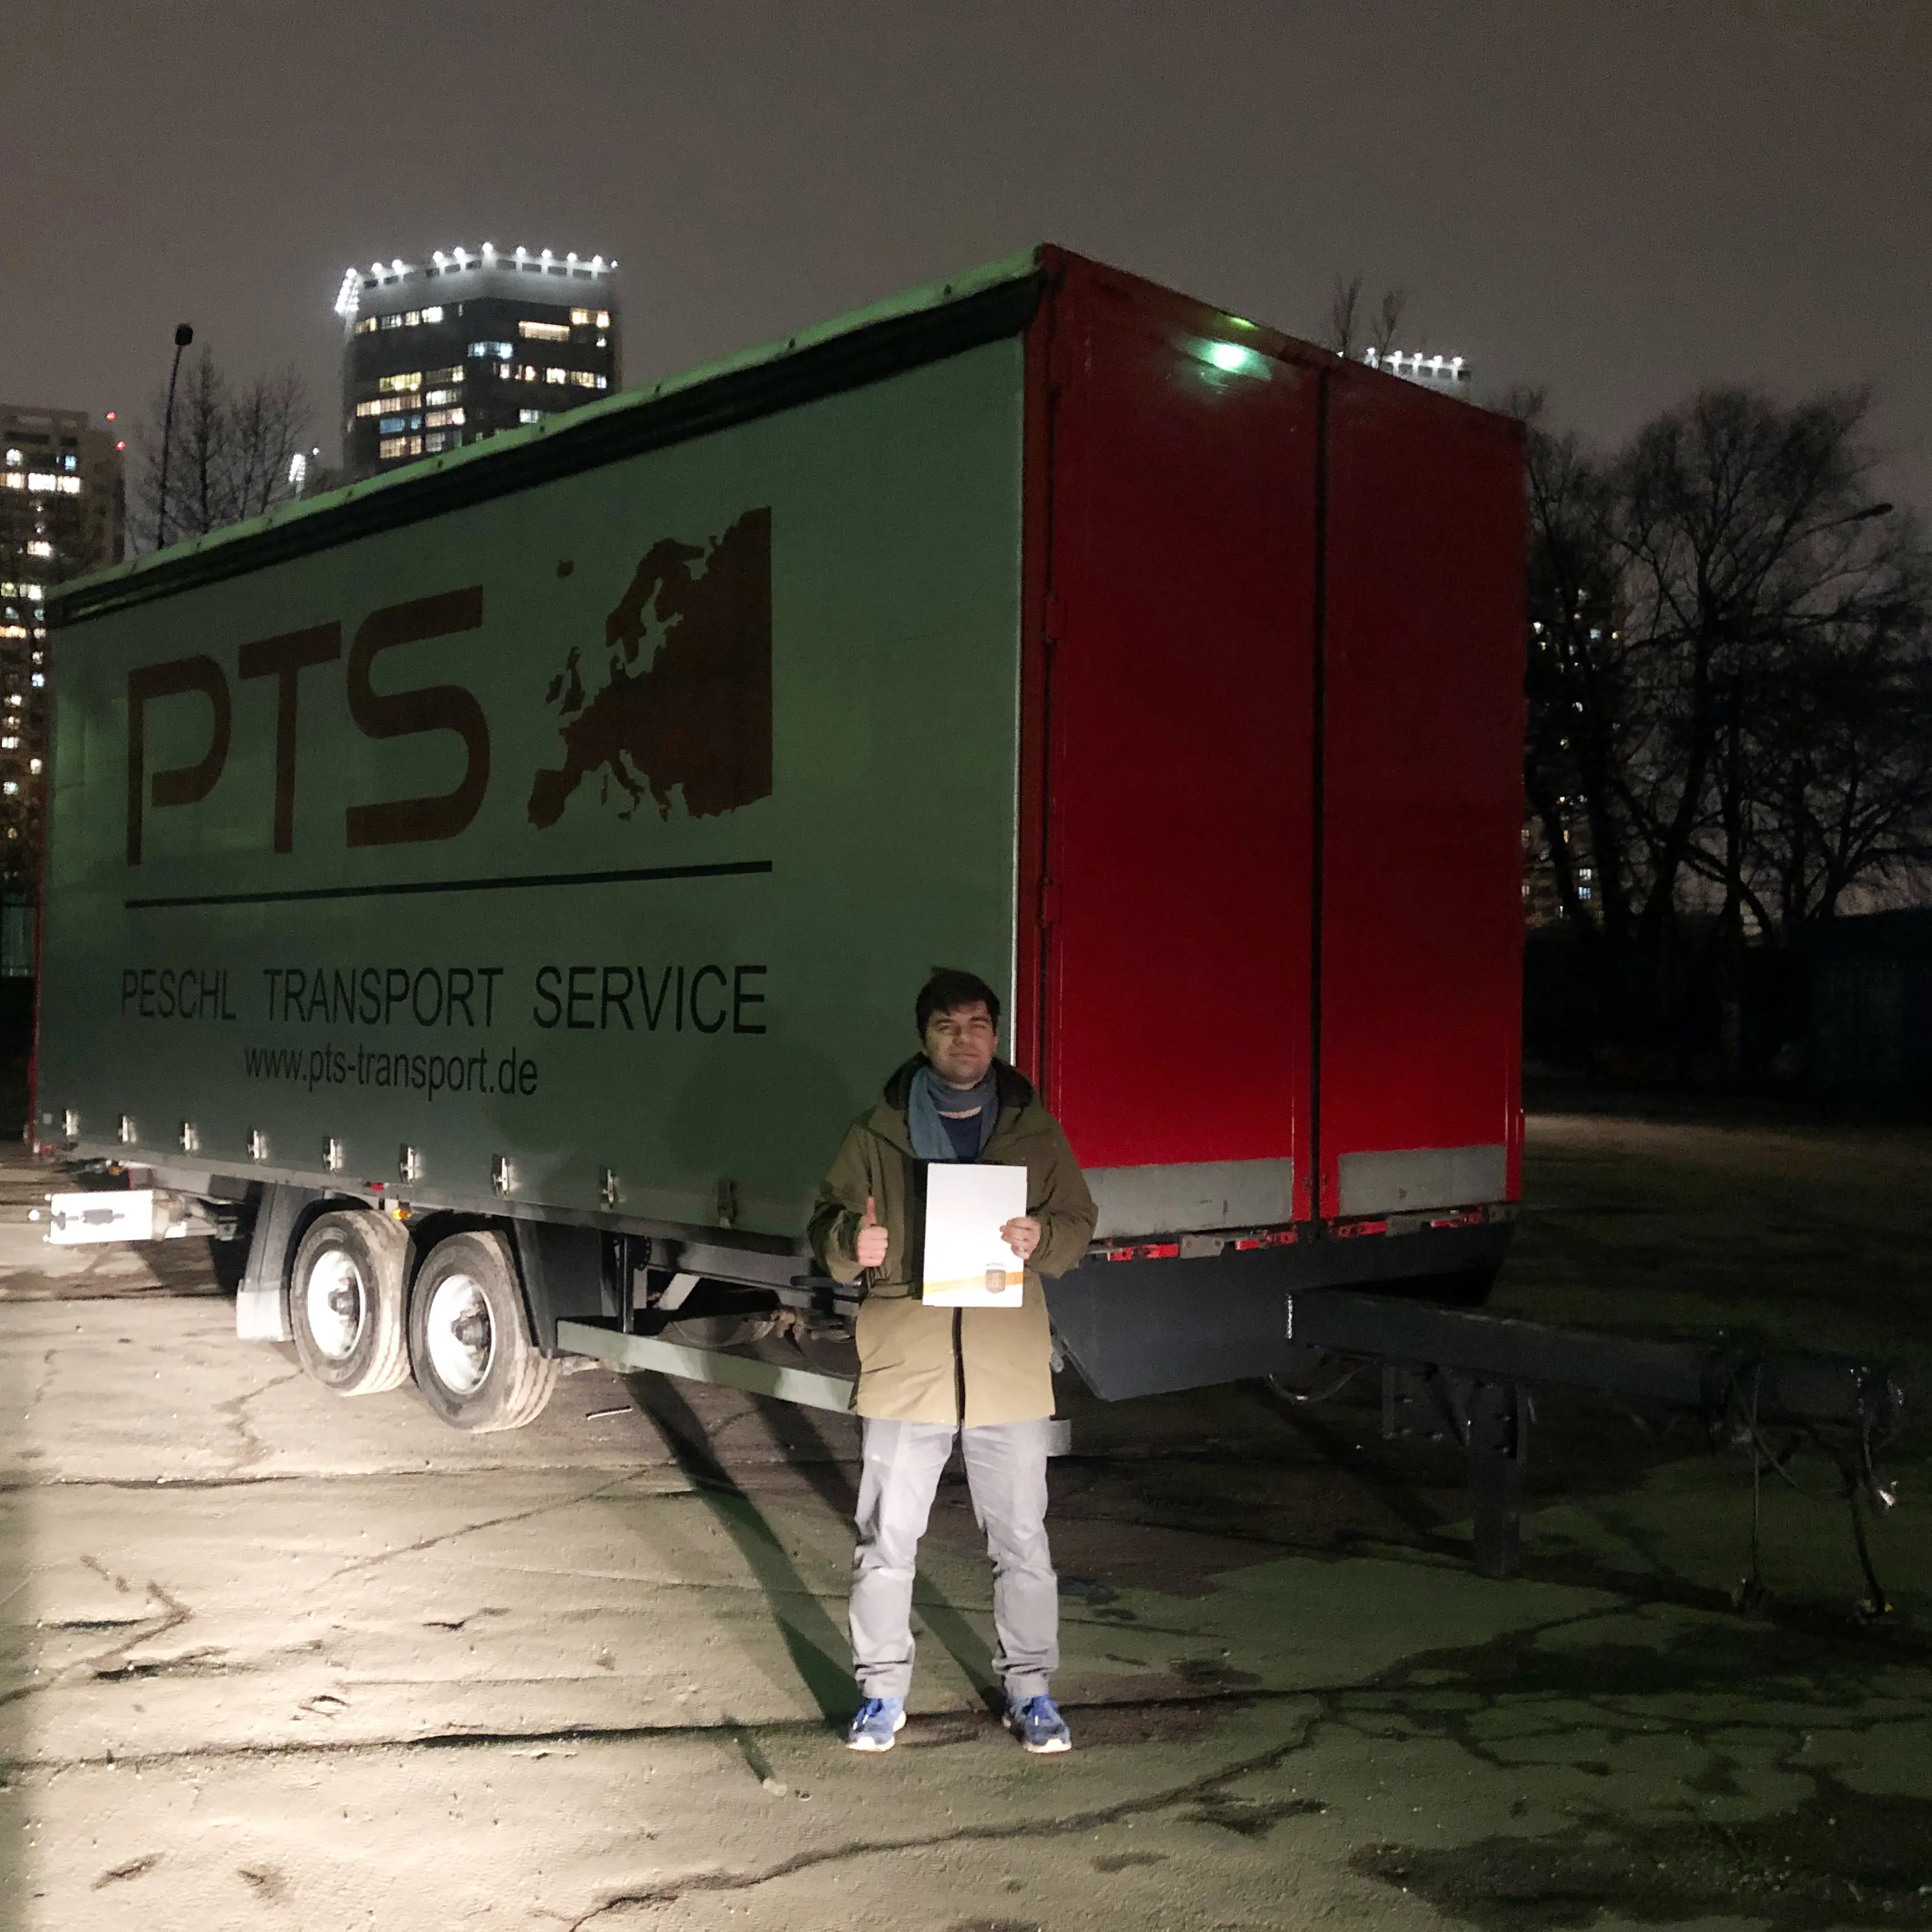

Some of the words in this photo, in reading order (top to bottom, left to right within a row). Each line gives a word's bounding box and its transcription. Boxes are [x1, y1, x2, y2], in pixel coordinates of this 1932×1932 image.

[127, 585, 491, 867] PTS
[121, 968, 236, 1020] PESCHL
[263, 967, 503, 1027] TRANSPORT
[533, 965, 767, 1034] SERVICE
[245, 1044, 538, 1101] www.pts-transport.de
